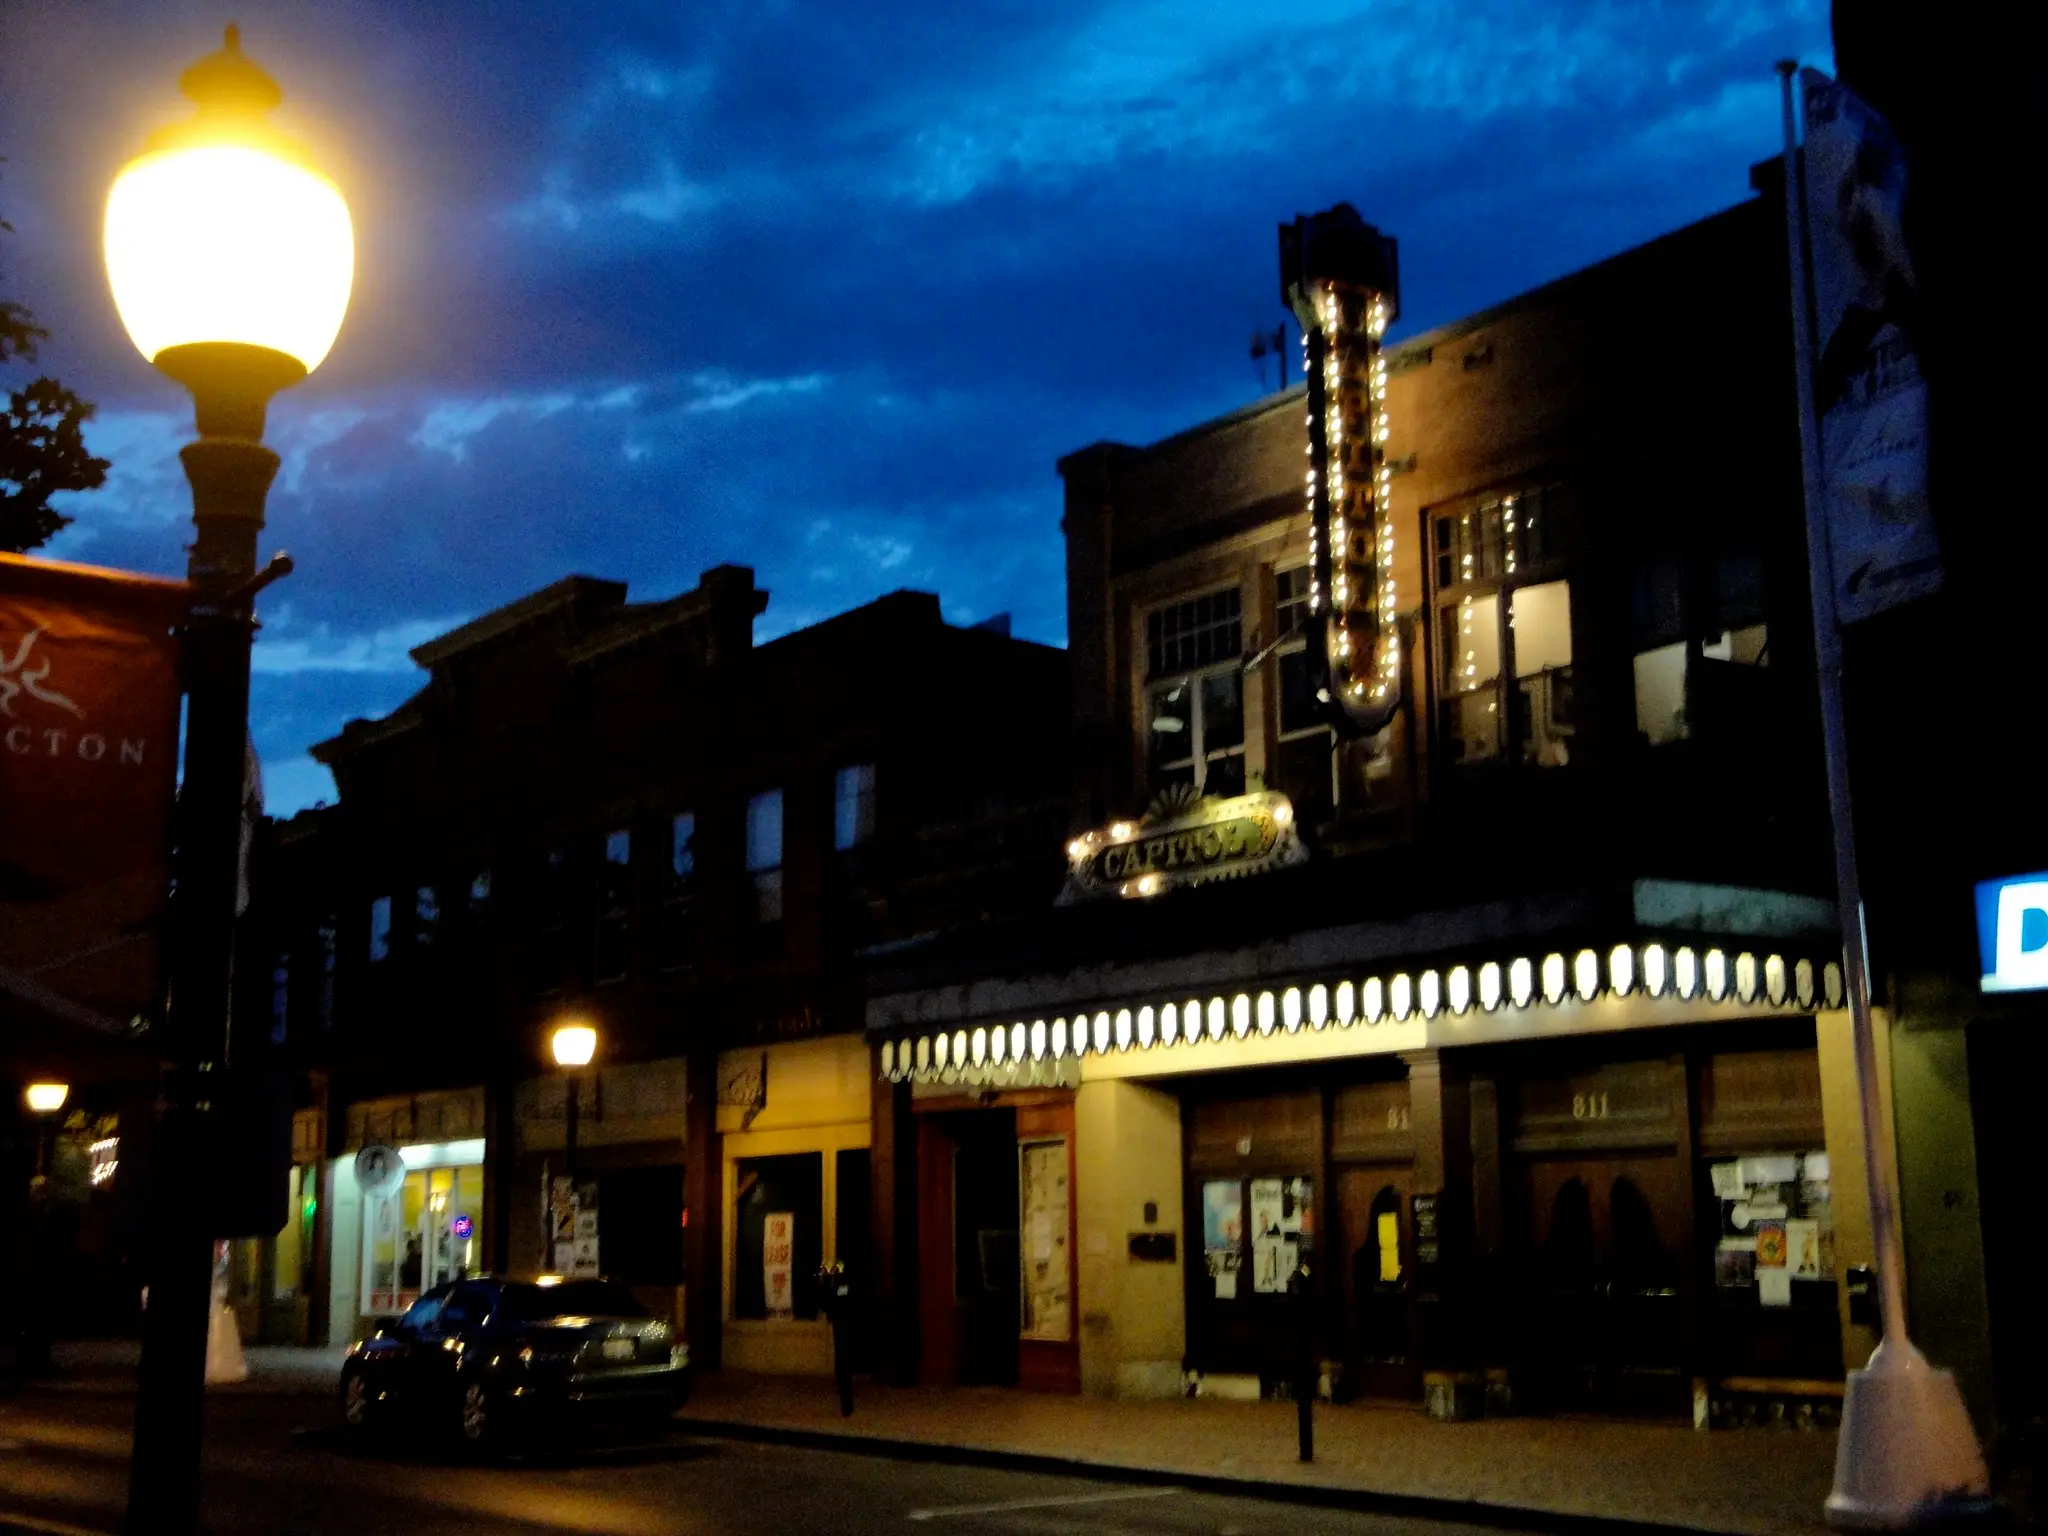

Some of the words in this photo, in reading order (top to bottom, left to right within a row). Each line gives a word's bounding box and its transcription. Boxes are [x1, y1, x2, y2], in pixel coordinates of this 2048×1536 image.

[4, 723, 148, 767] CTON
[1102, 824, 1248, 880] CAPITOL
[1572, 1091, 1608, 1119] 811
